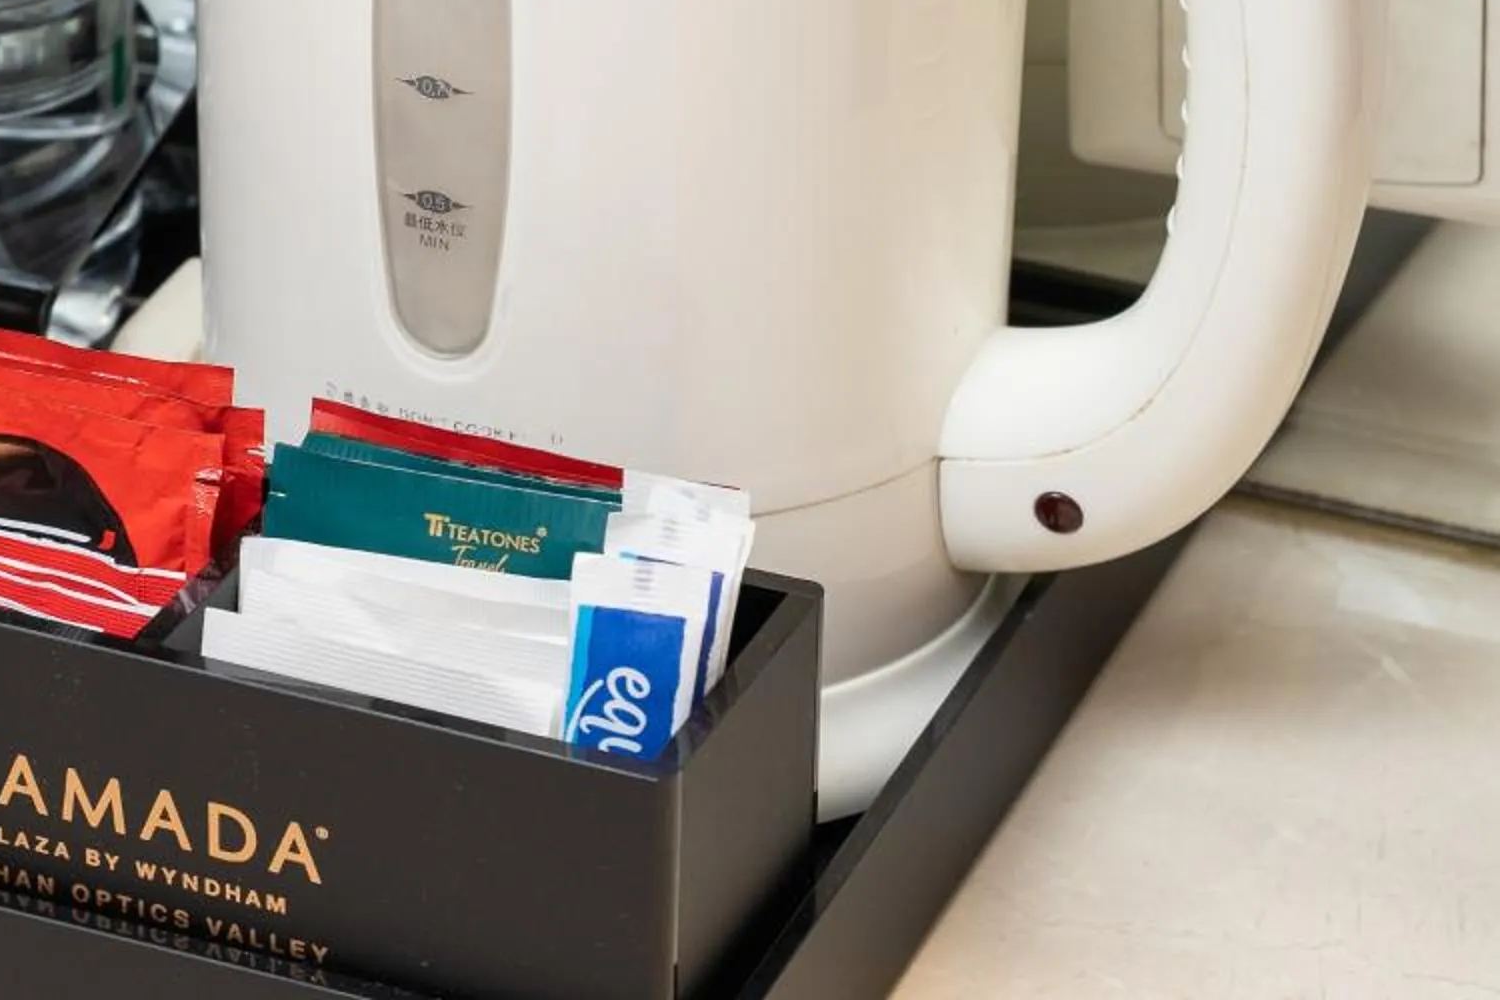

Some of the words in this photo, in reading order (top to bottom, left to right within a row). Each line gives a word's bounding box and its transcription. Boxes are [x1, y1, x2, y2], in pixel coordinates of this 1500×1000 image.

[404, 211, 467, 237] 最低水位
[418, 233, 451, 252] MIN
[447, 522, 542, 554] TEATONES
[84, 848, 121, 872] BY
[134, 860, 288, 915] WYNDHAM
[70, 882, 191, 930] OPTICS
[205, 915, 330, 965] VALLEY
